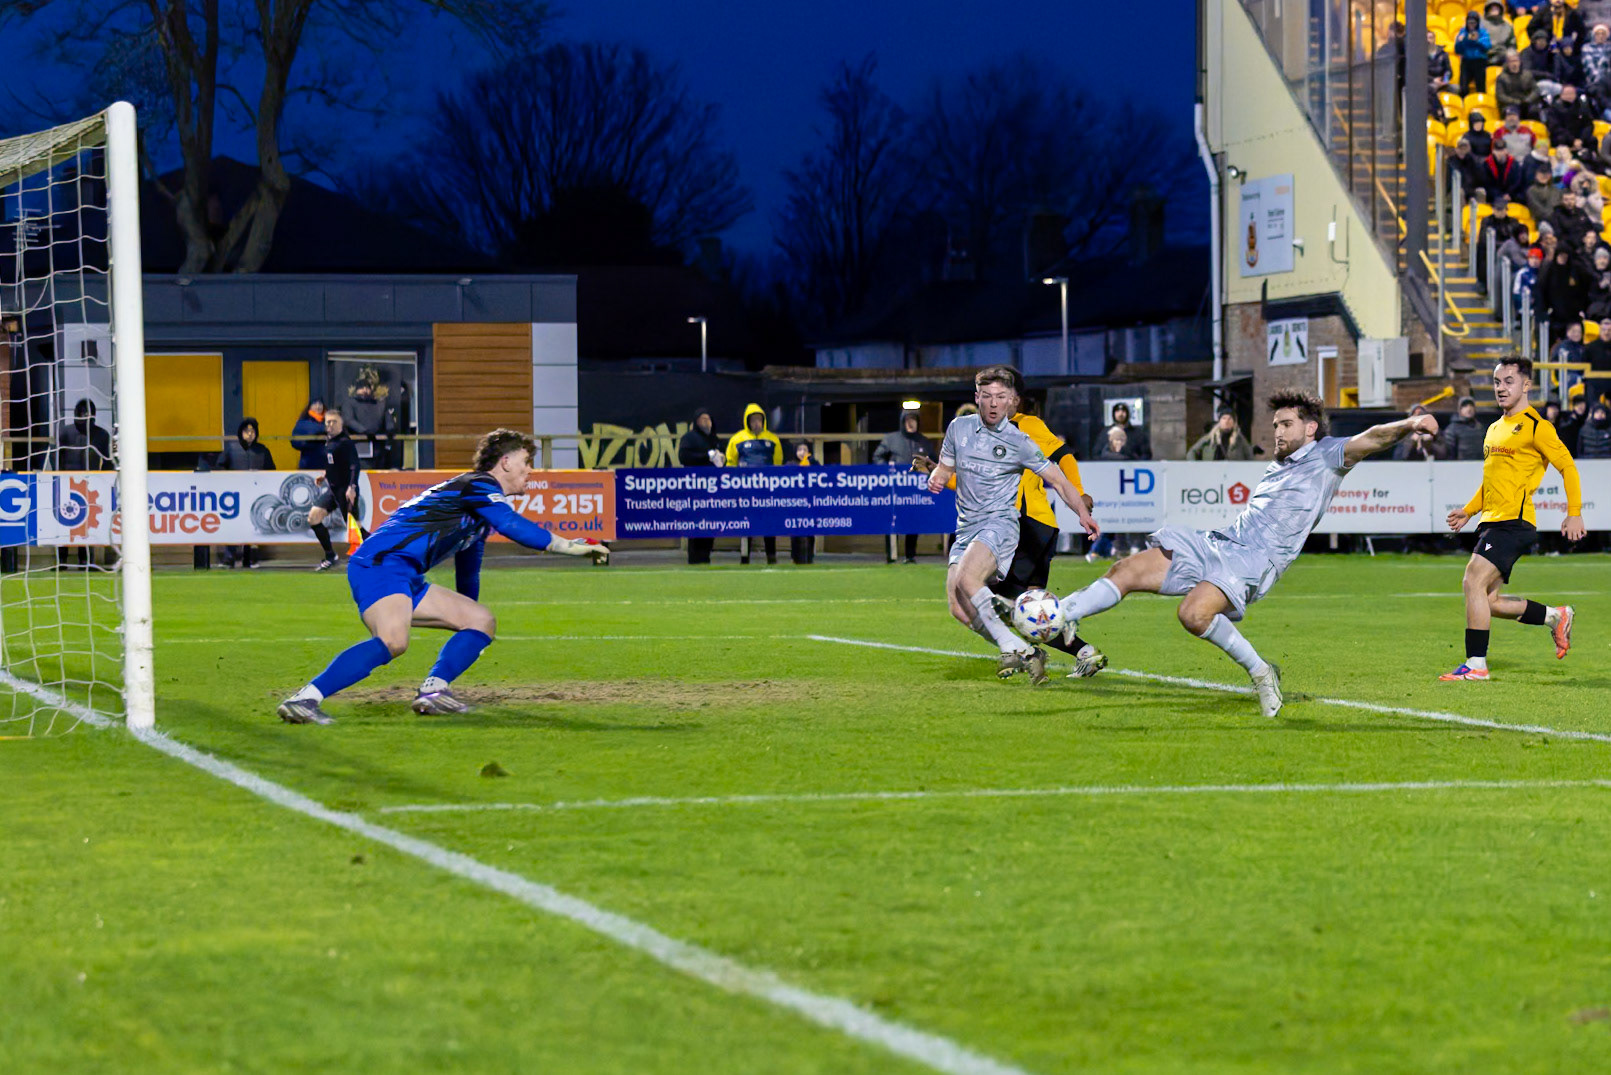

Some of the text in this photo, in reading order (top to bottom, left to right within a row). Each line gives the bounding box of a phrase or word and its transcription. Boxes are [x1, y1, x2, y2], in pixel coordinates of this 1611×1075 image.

[525, 480, 549, 489] RING
[624, 470, 929, 494] Supporting Southport FC. Supporting
[1119, 468, 1155, 495] HD
[111, 485, 240, 520] aring
[552, 493, 604, 514] 2151
[624, 493, 936, 512] Trusted legal partners to businesses, individuals and families.
[1181, 483, 1224, 505] real
[1372, 488, 1389, 498] for
[1361, 503, 1415, 513] Referrals
[111, 512, 221, 534] surce
[624, 518, 852, 532] www.harrison-drury.com 01704 269988
